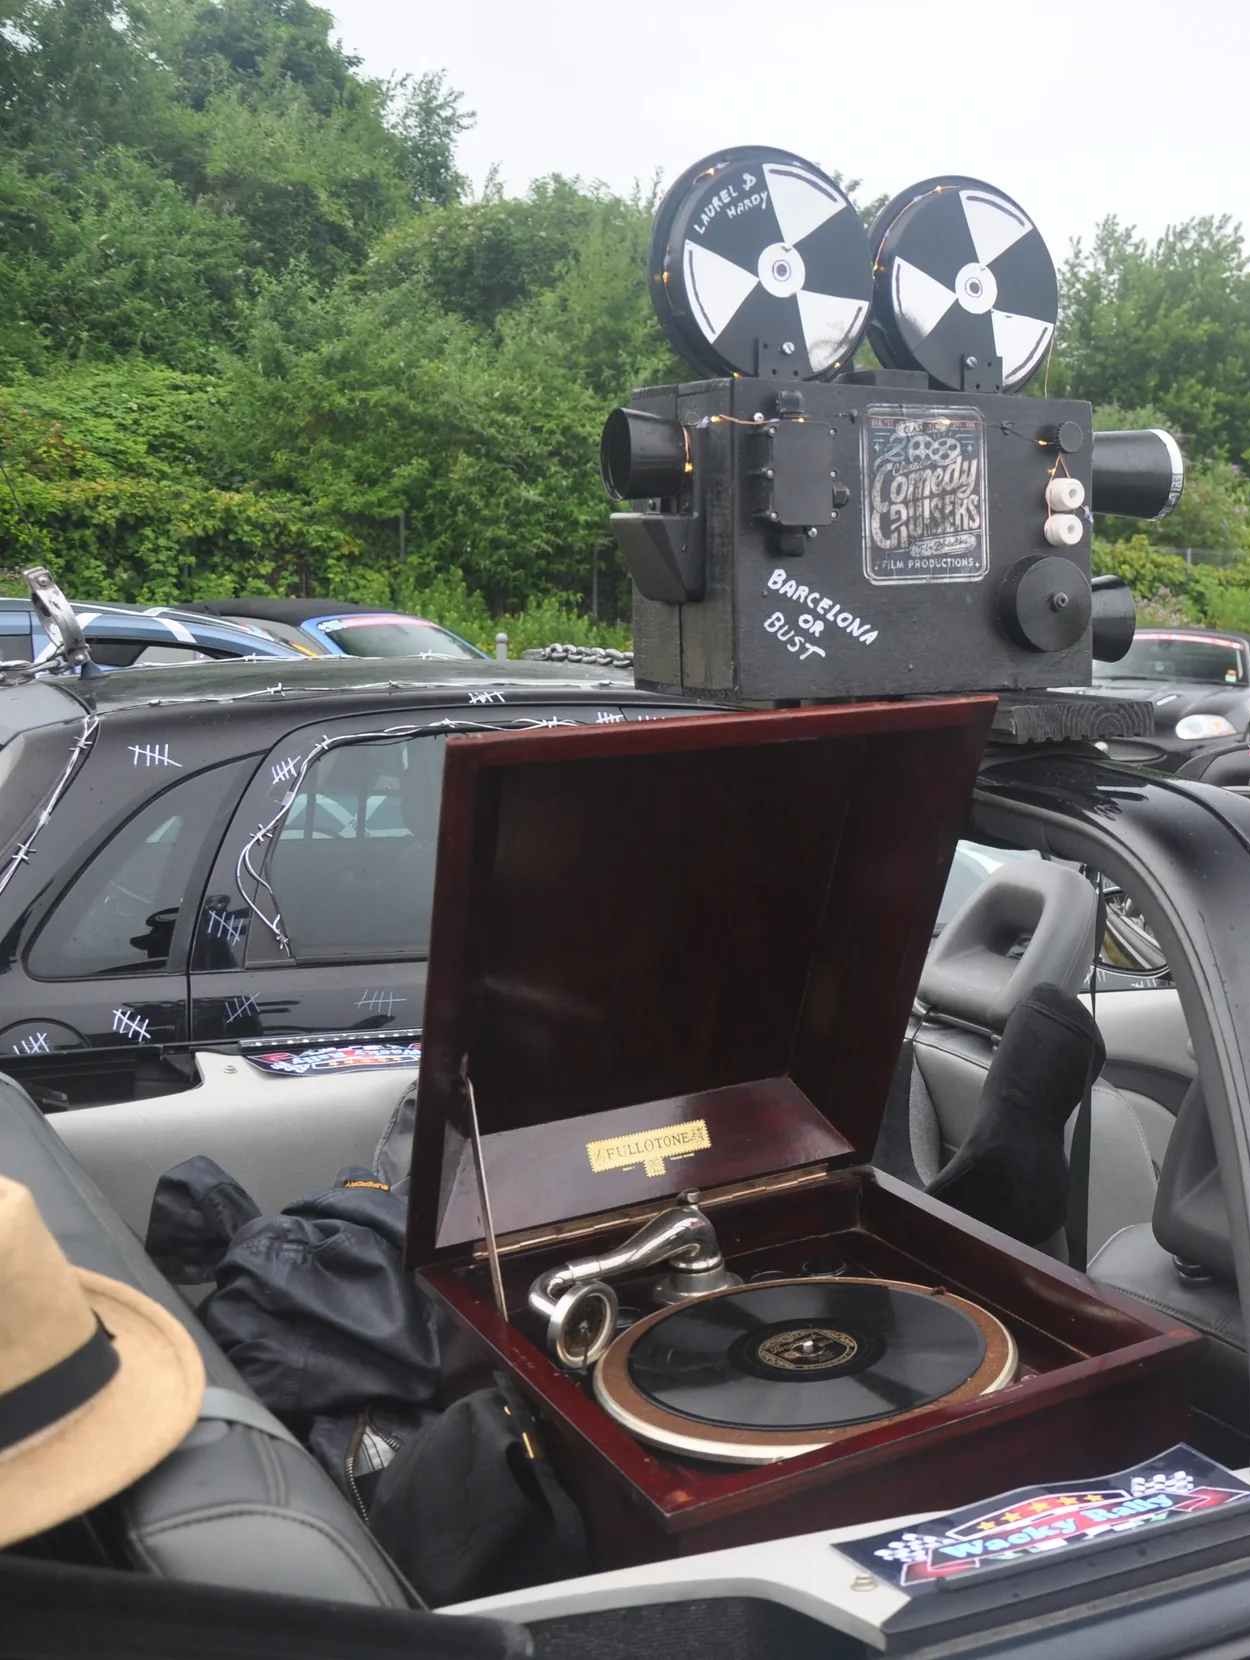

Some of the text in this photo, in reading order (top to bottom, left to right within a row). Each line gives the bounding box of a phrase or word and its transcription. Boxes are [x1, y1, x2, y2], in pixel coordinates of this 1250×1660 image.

[693, 185, 738, 234] LAUREL
[726, 190, 768, 219] HARDY
[871, 455, 978, 513] Comedy
[881, 557, 974, 569] FILM PRODUCTIONS
[767, 568, 879, 645] BARCELONA
[798, 613, 825, 637] OR
[763, 611, 826, 660] BUST
[292, 1051, 346, 1065] Rally
[605, 1131, 692, 1160] FULLOTONE
[937, 1493, 1174, 1560] Wacky Rally
